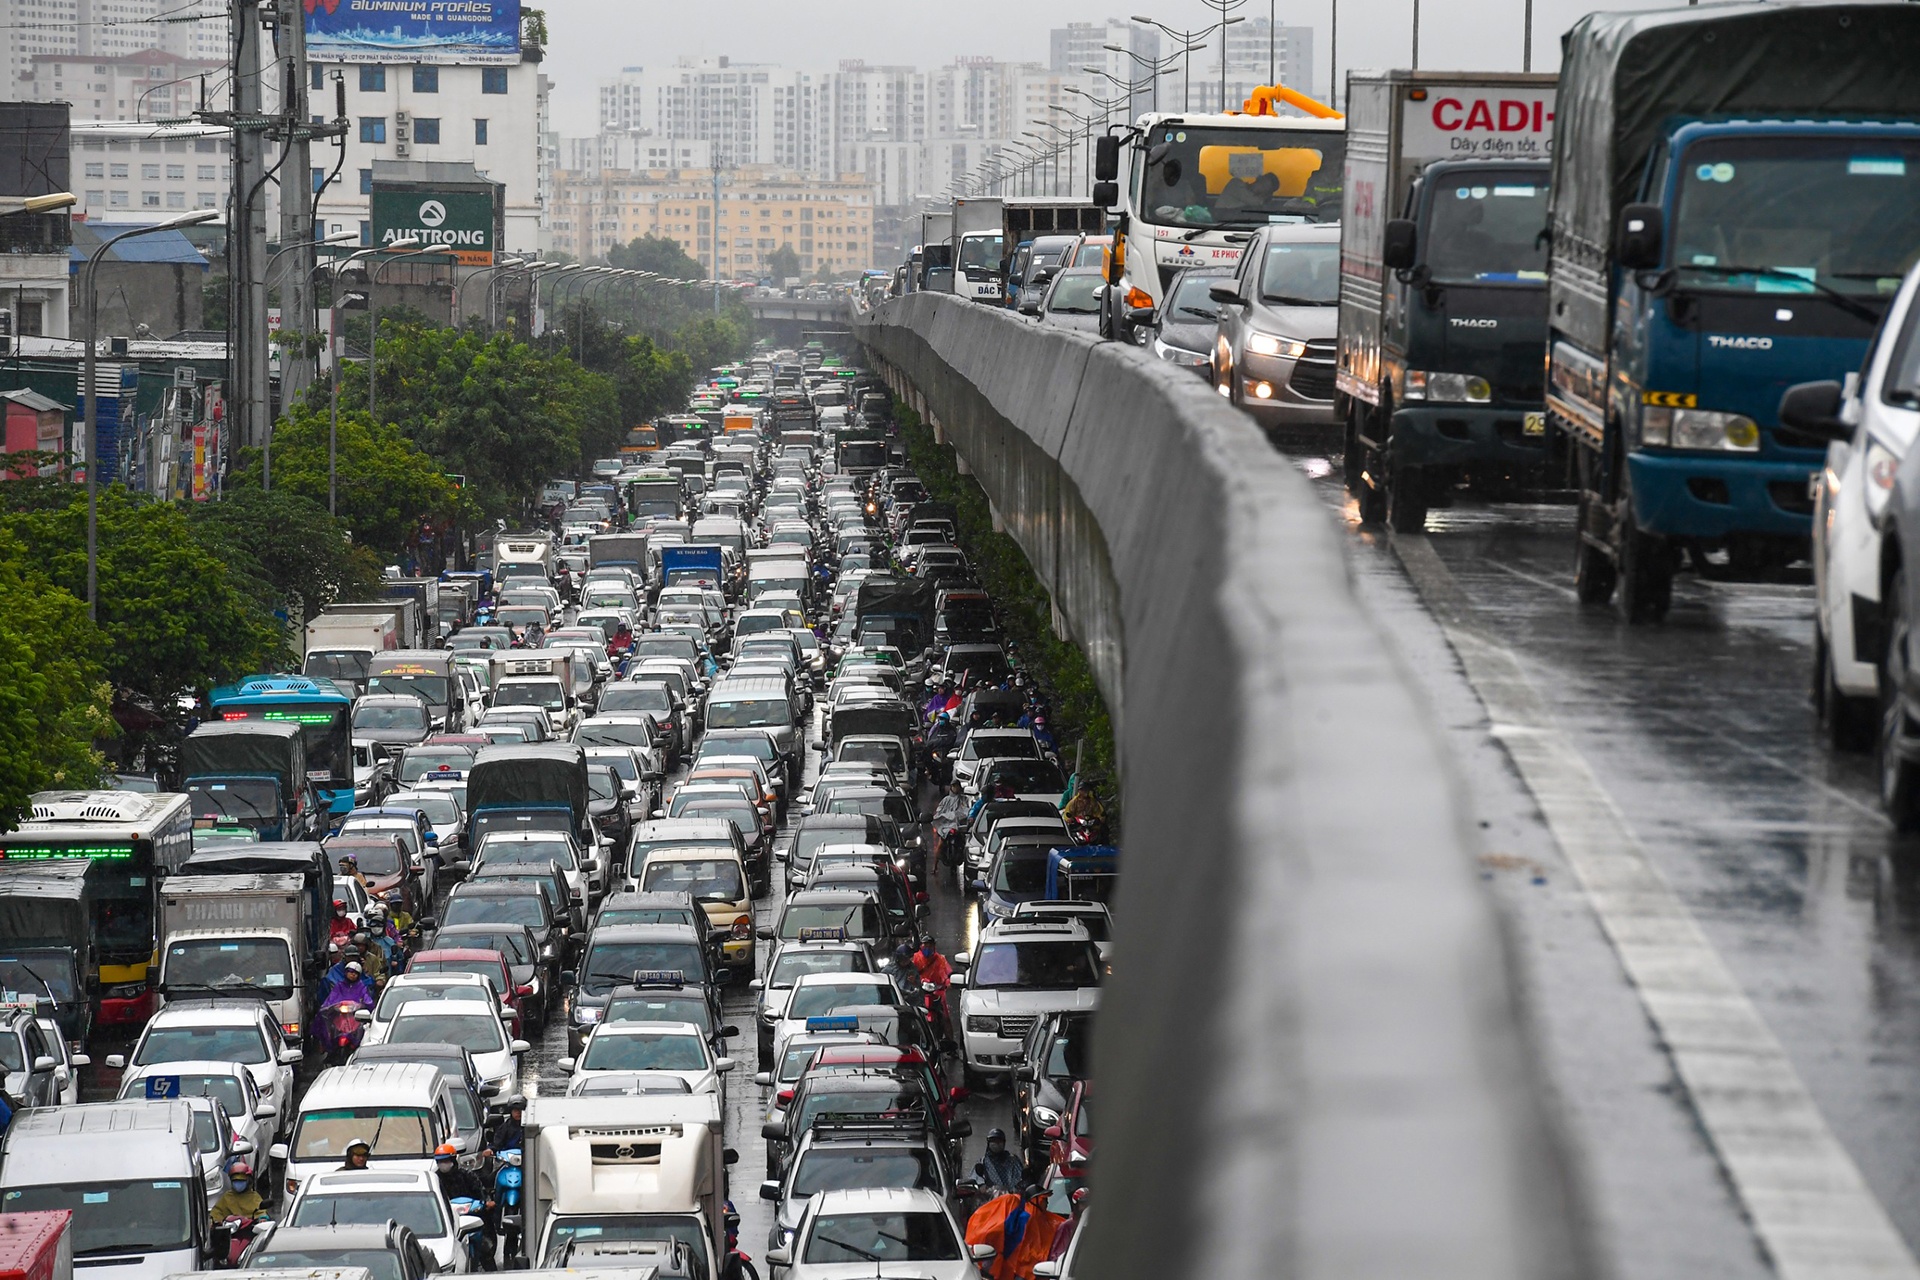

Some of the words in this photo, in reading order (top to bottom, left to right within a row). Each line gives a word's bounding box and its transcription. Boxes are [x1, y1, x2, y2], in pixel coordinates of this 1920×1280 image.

[411, 13, 431, 21] MADE
[447, 14, 493, 22] GUANGDONG
[1450, 137, 1479, 153] Dây
[1482, 137, 1514, 151] điện
[381, 228, 485, 245] AUSTRONG
[1212, 250, 1220, 259] XE
[1221, 250, 1239, 260] PHỤC
[1162, 257, 1206, 266] HINO
[1450, 318, 1498, 328] THACO
[1708, 335, 1773, 350] THACO
[185, 900, 244, 920] THÀNH
[249, 899, 278, 919] MỸ
[812, 930, 823, 938] SAO
[153, 1077, 172, 1095] G7
